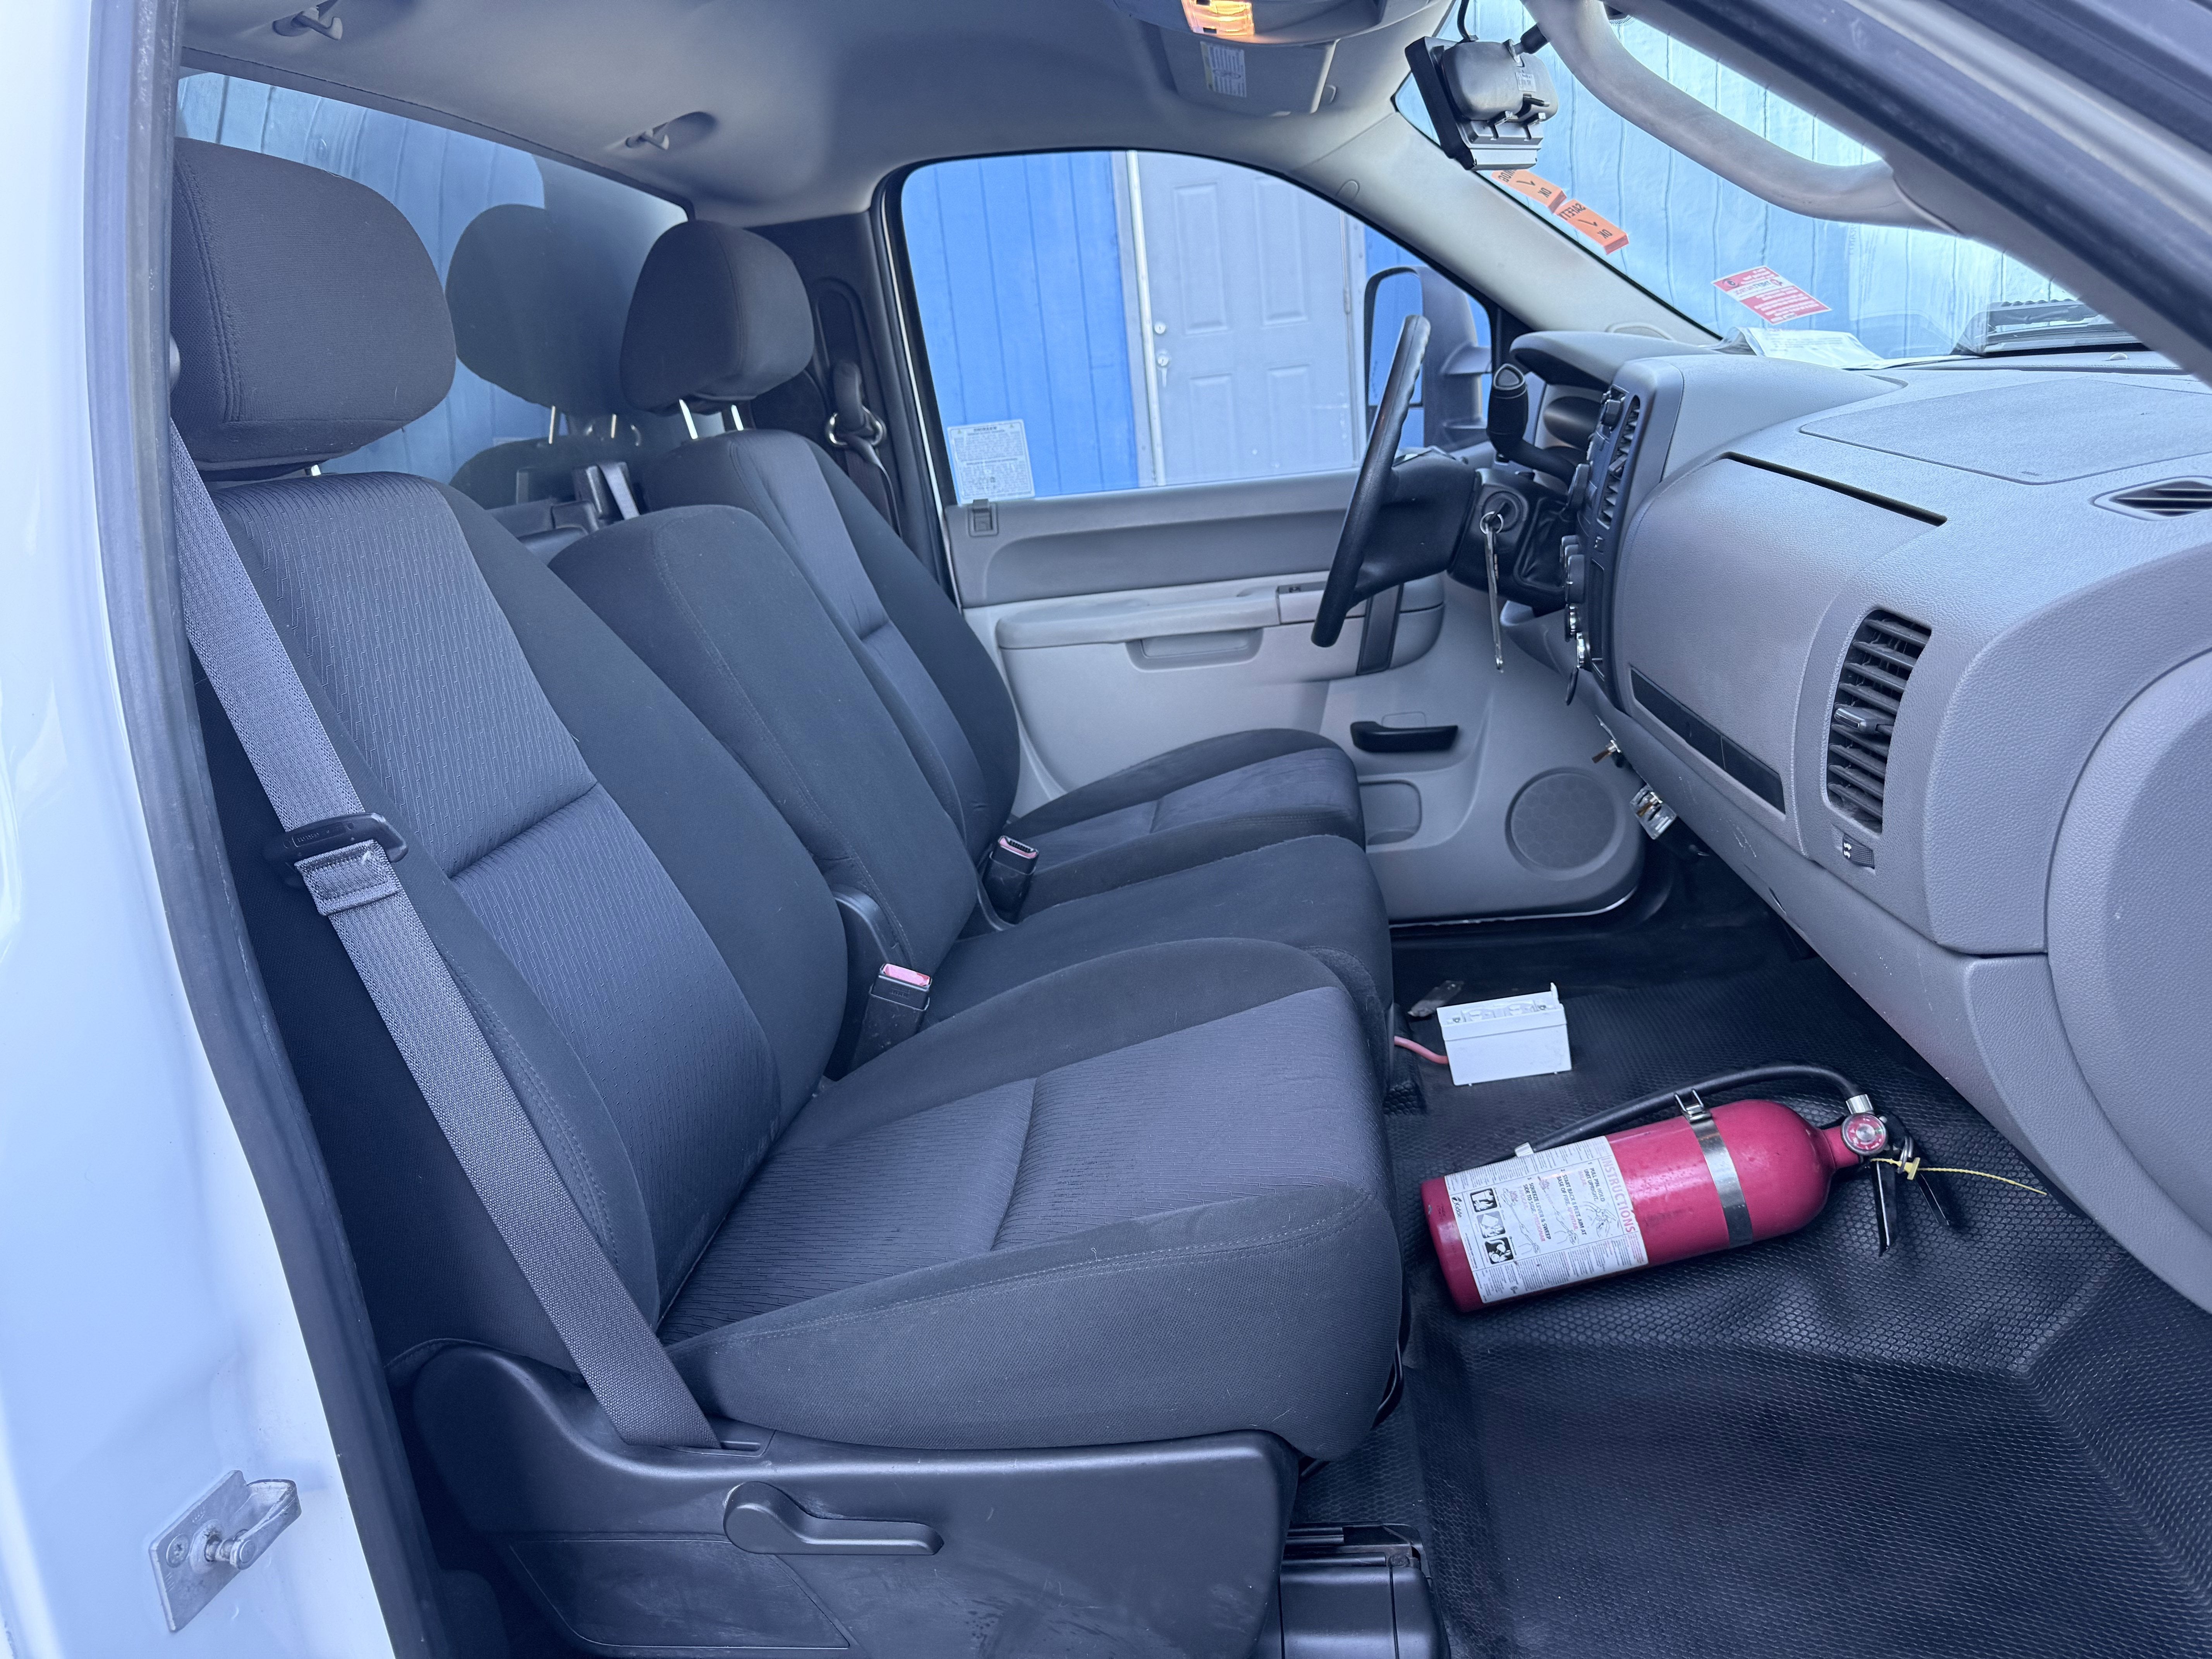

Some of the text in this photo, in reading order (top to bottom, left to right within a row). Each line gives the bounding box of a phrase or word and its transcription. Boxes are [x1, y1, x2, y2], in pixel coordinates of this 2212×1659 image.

[1562, 1174, 1571, 1188] START
[1587, 1179, 1599, 1201] UPRIGHT.
[1597, 1188, 1605, 1202] HOLD
[1601, 1157, 1636, 1233] INSTRUCTIONS
[1453, 1202, 1463, 1218] Kidde
[1528, 1182, 1539, 1202] SQUEEZE
[1535, 1202, 1544, 1218] LEVER
[1542, 1223, 1551, 1240] SWEEP
[1532, 1213, 1546, 1242] PRESIONAR
